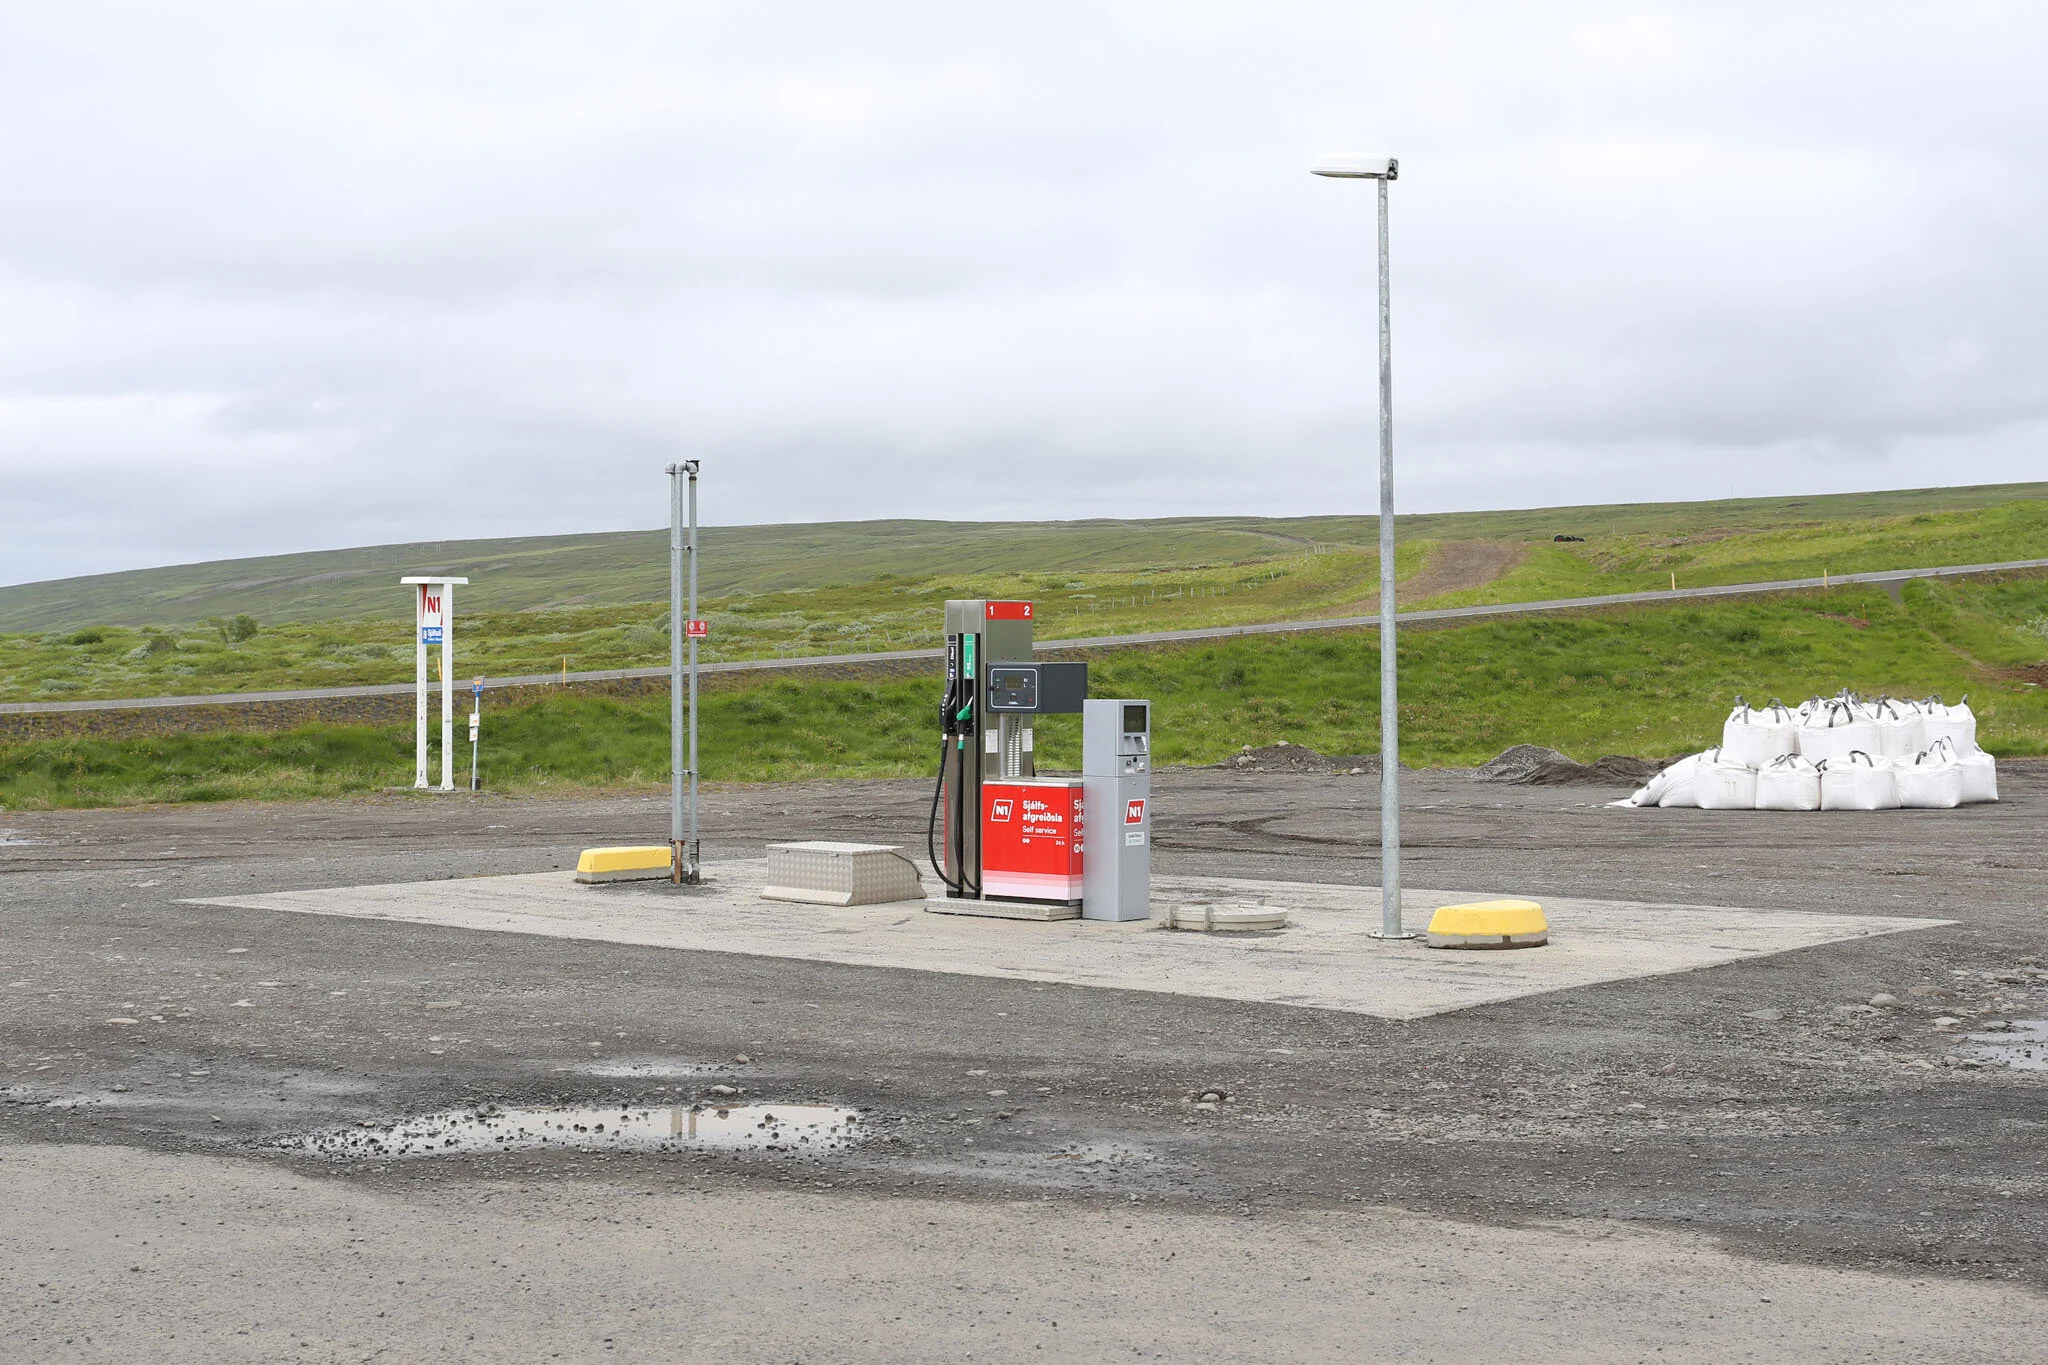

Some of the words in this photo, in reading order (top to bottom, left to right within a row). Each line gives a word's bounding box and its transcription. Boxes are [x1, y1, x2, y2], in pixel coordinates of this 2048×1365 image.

[427, 596, 441, 613] N1
[989, 605, 994, 616] 1
[1024, 605, 1030, 616] 2
[995, 806, 1009, 816] N1
[1022, 800, 1049, 812] Sjálfs-
[1022, 812, 1063, 823] afgreiðsla
[1130, 806, 1141, 818] N1
[1022, 825, 1035, 834] Self
[1035, 827, 1057, 835] service
